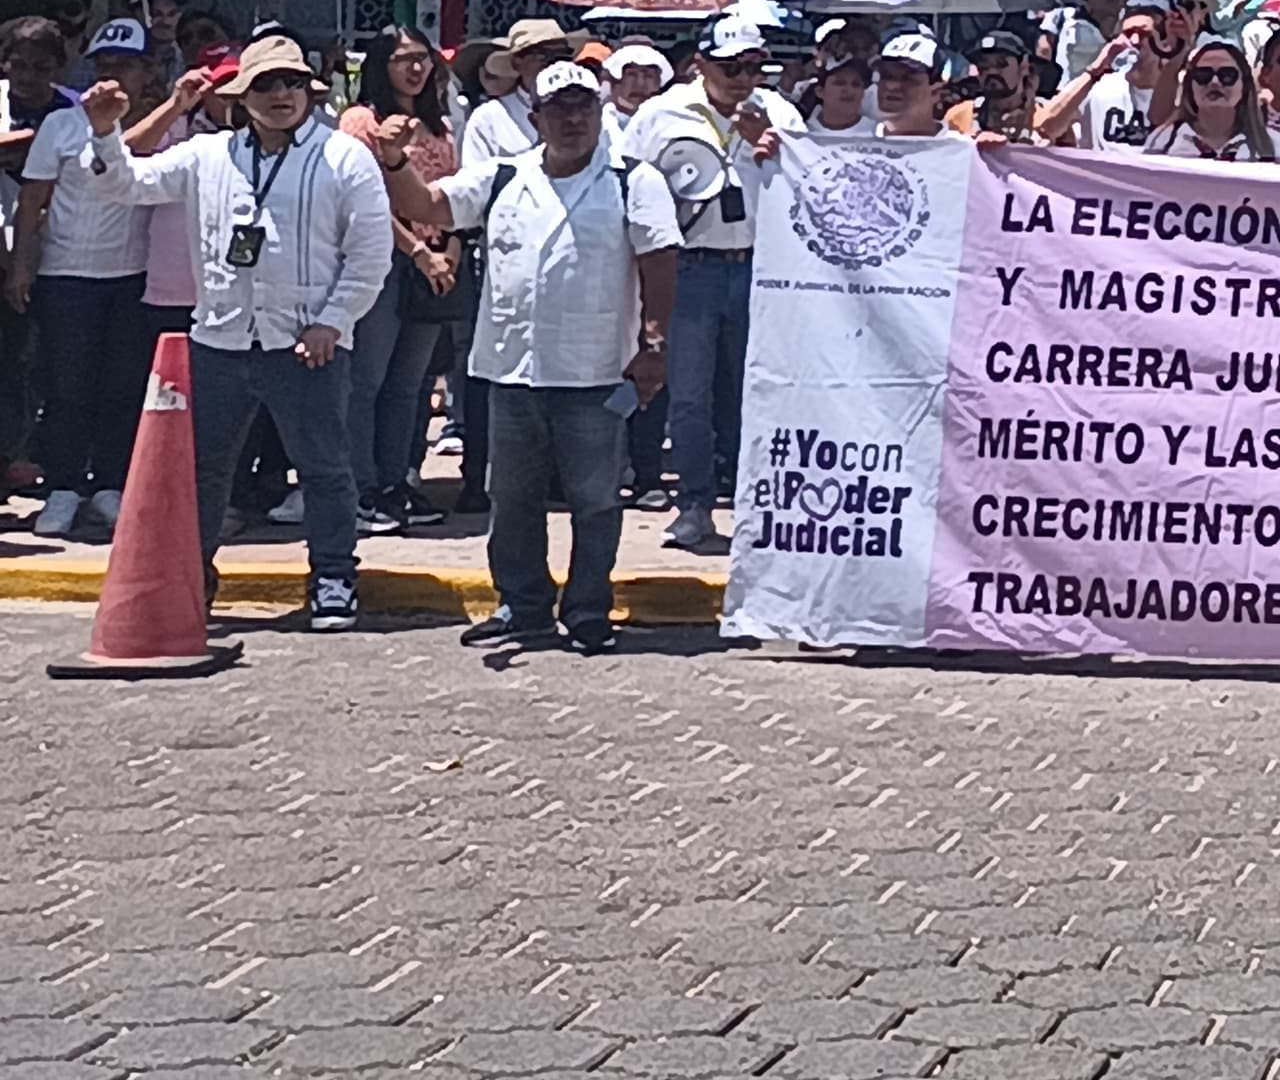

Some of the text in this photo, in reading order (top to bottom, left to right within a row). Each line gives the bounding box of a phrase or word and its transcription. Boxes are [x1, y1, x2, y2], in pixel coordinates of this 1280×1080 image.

[1001, 193, 1054, 233] LA
[996, 266, 1026, 306] Y
[985, 341, 1193, 391] CARRERA
[977, 409, 1145, 465] MÉRITO
[1161, 425, 1191, 466] Y
[752, 511, 903, 558] Judicial
